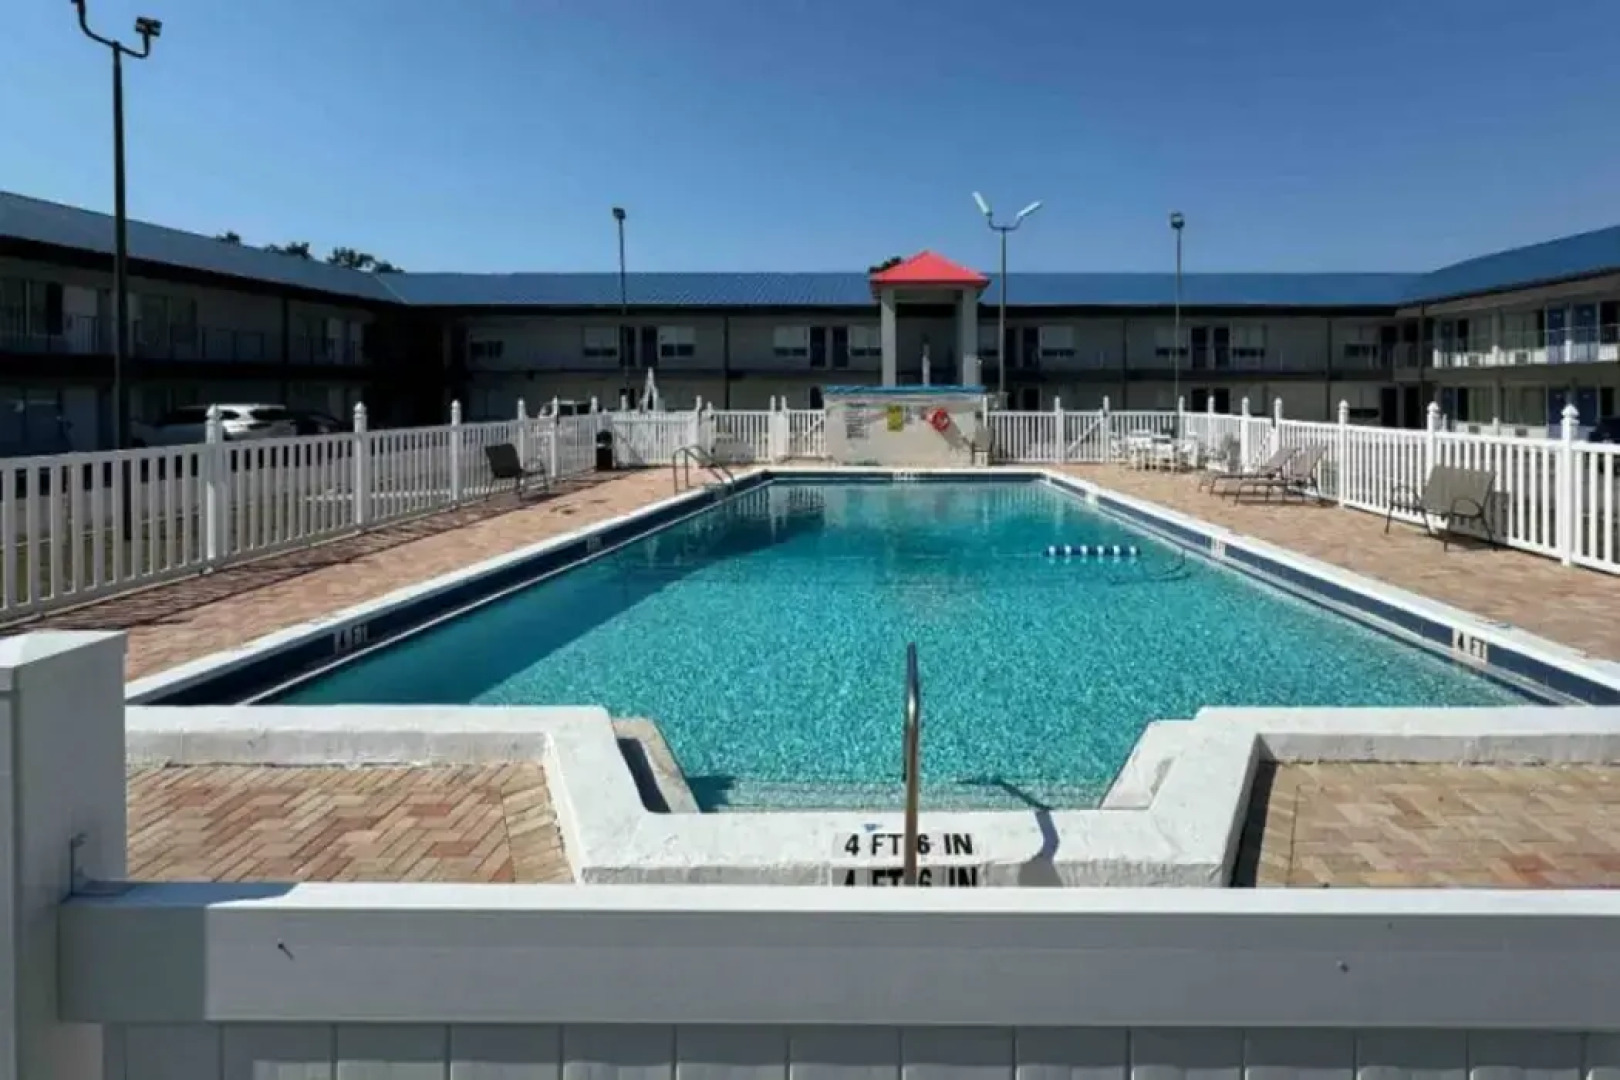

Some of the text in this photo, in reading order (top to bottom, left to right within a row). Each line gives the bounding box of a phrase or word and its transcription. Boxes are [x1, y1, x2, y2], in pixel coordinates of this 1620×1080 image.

[1457, 632, 1485, 658] 4 FT
[844, 833, 973, 855] 4 FT 6 IN
